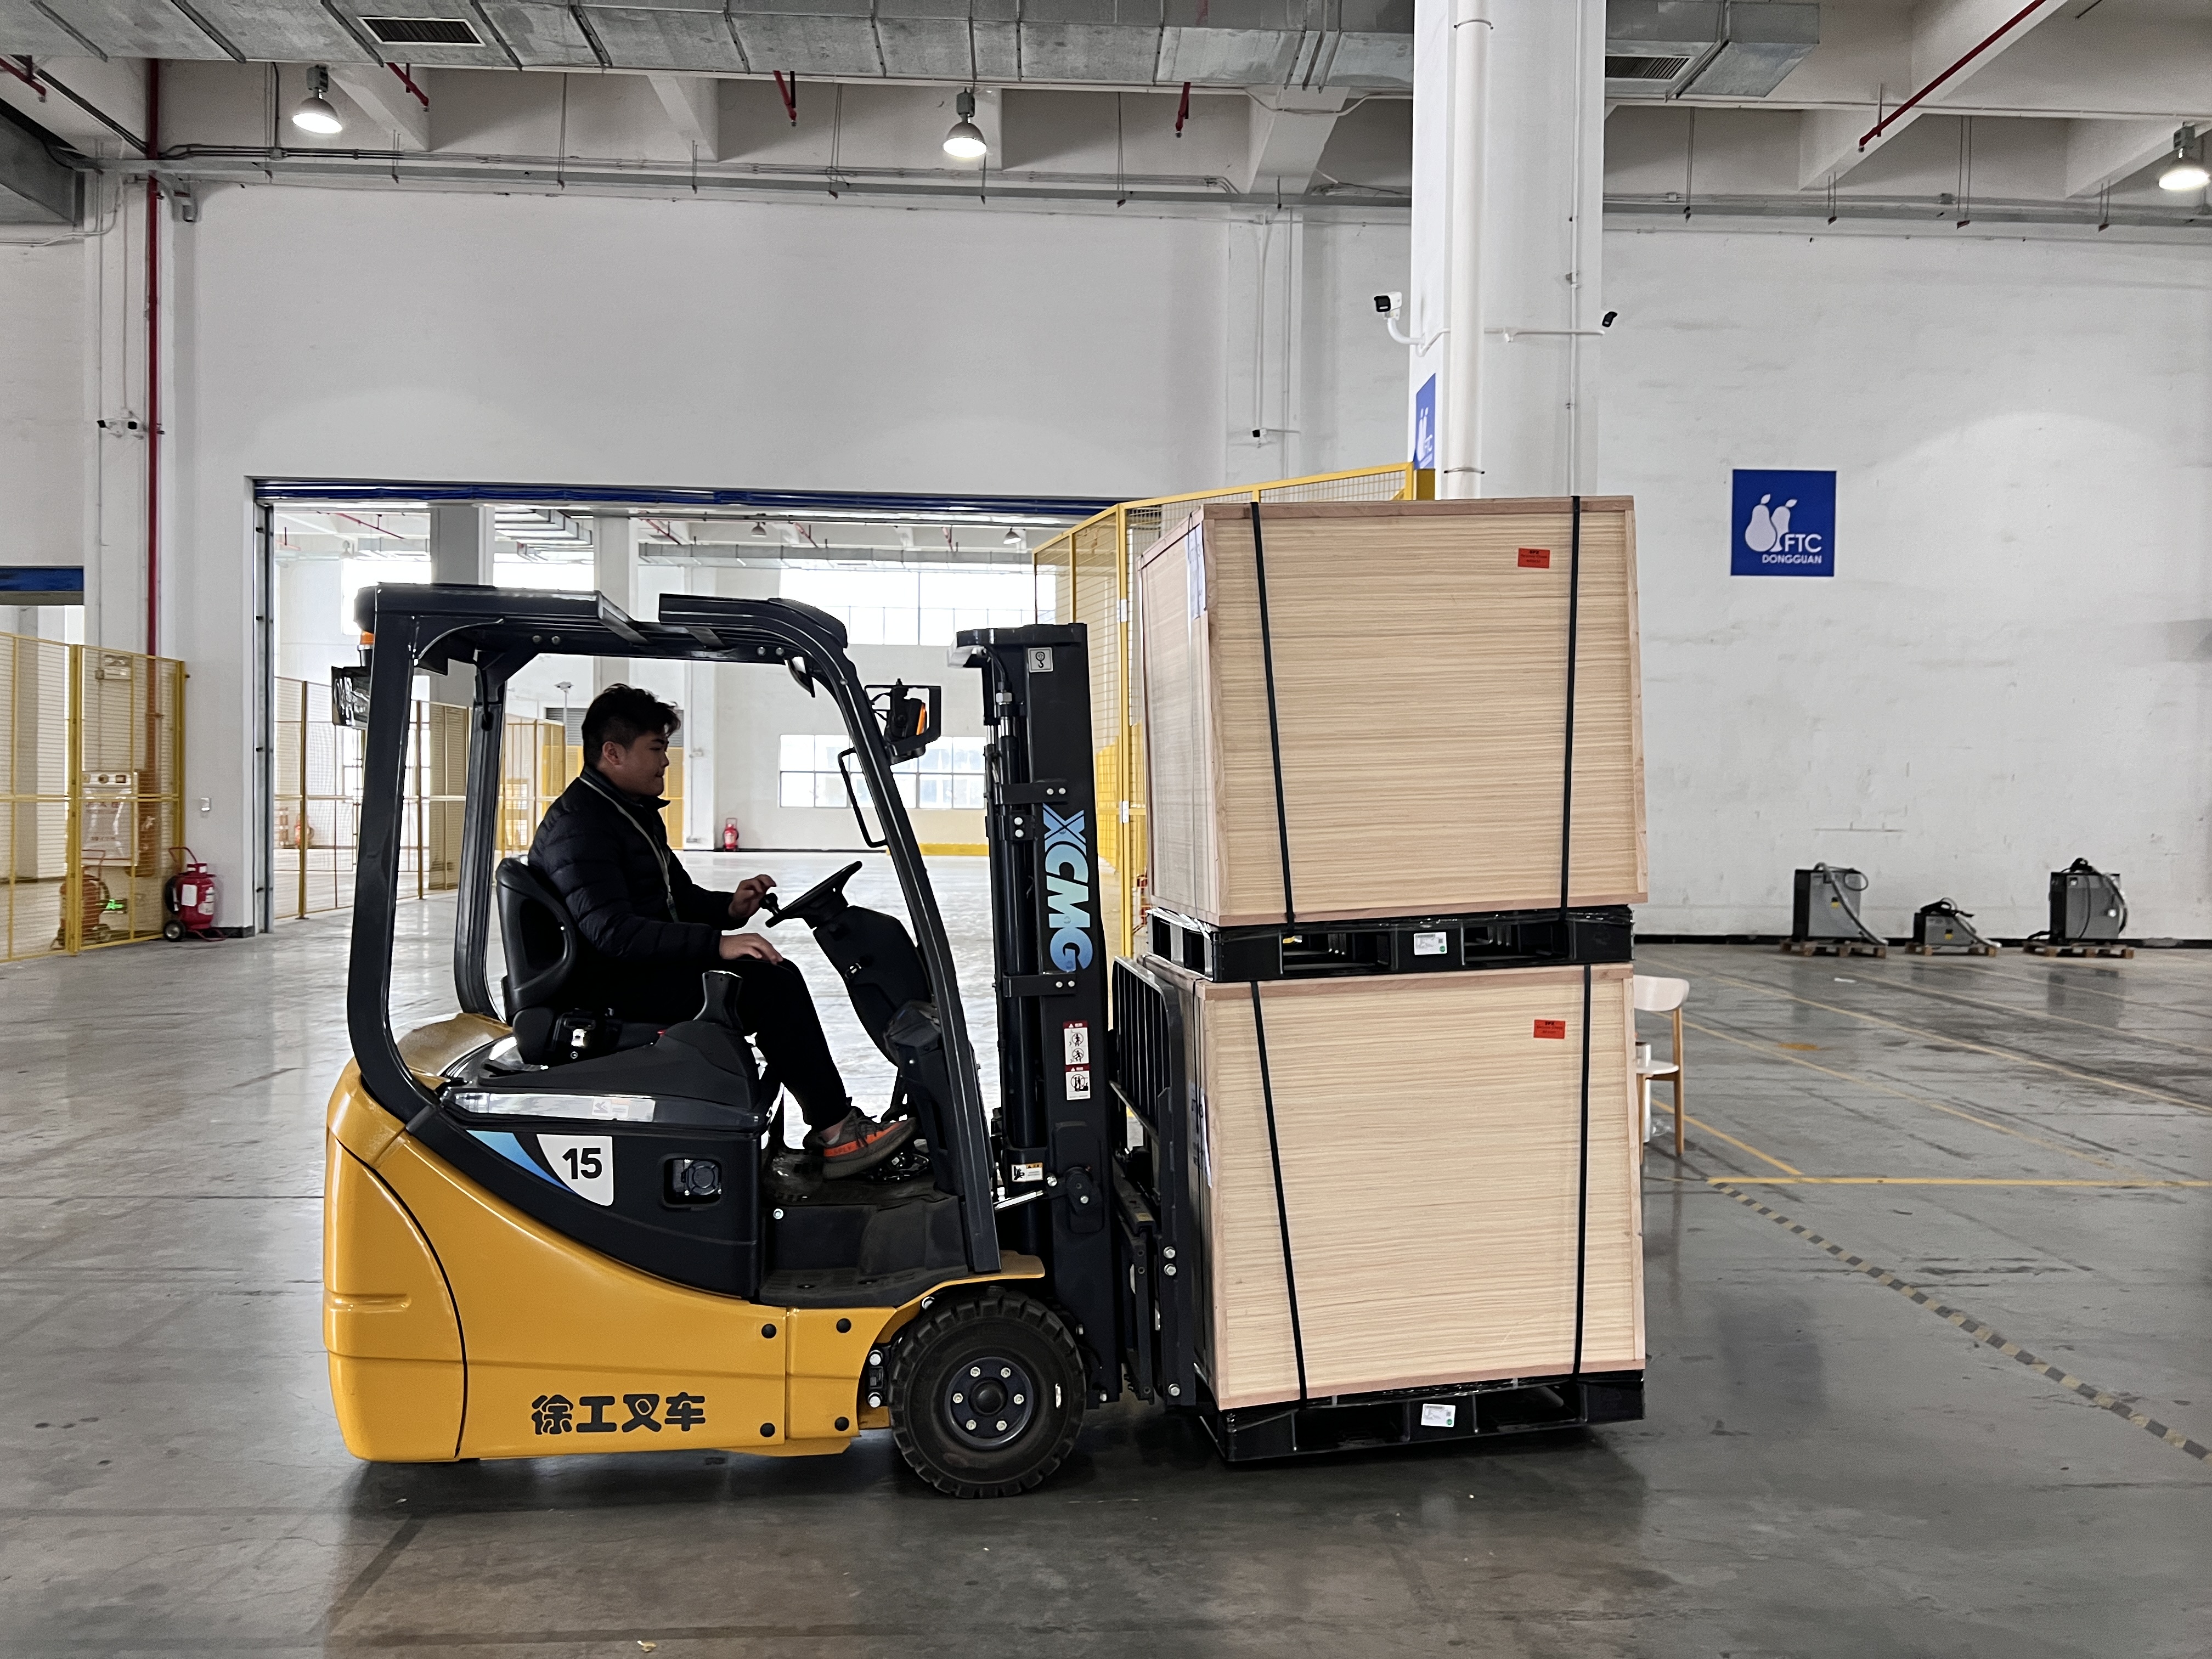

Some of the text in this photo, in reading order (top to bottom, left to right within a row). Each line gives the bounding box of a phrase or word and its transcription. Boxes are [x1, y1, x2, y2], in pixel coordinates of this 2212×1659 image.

[1762, 554, 1822, 564] DONGGUAN
[1784, 533, 1822, 553] FTC
[1042, 803, 1093, 973] XCMG
[561, 1147, 602, 1180] 15
[531, 1391, 706, 1435] 徐工叉车
